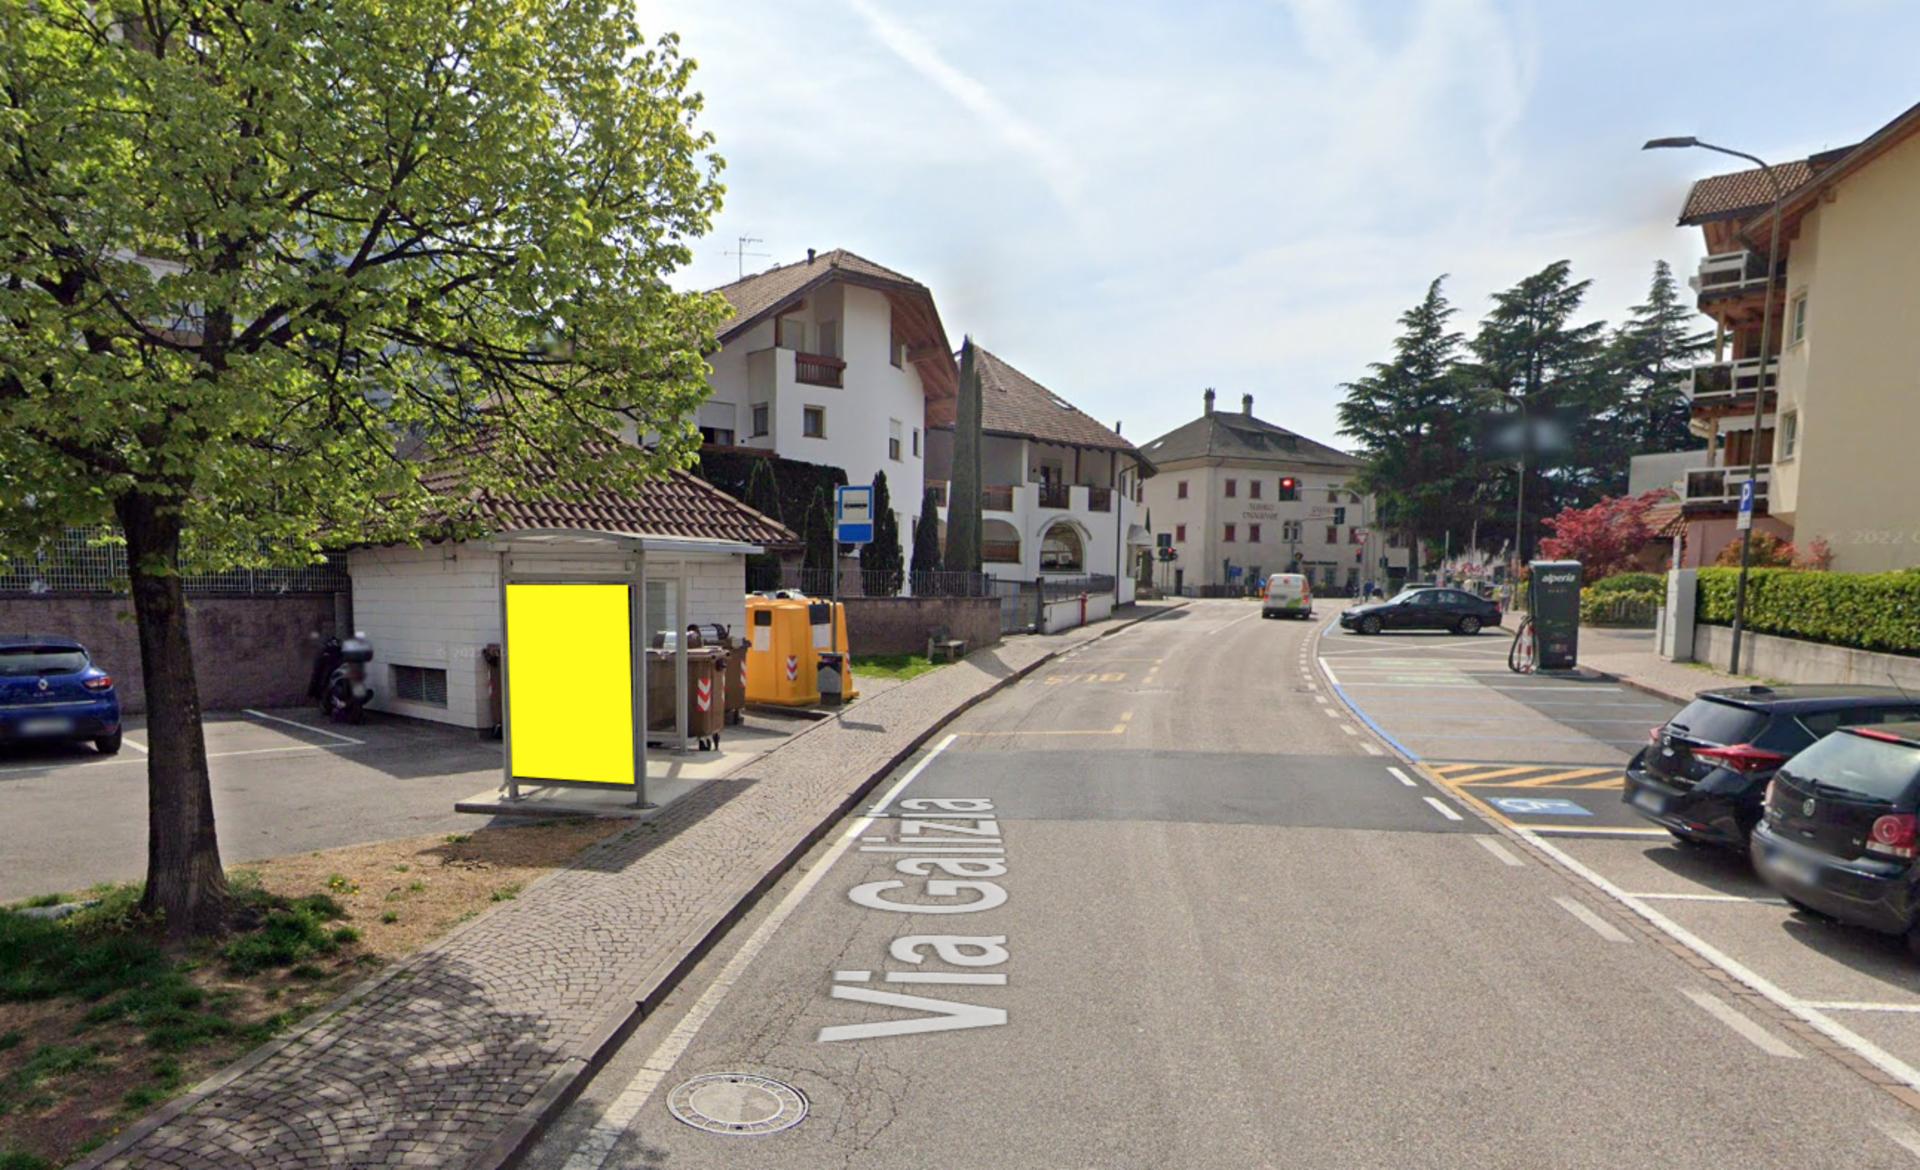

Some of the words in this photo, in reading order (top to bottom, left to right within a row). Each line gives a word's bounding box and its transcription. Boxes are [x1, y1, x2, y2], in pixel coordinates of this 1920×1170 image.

[1541, 573, 1576, 585] alperia
[848, 798, 1009, 914] Galizia
[817, 935, 1010, 1042] Via
